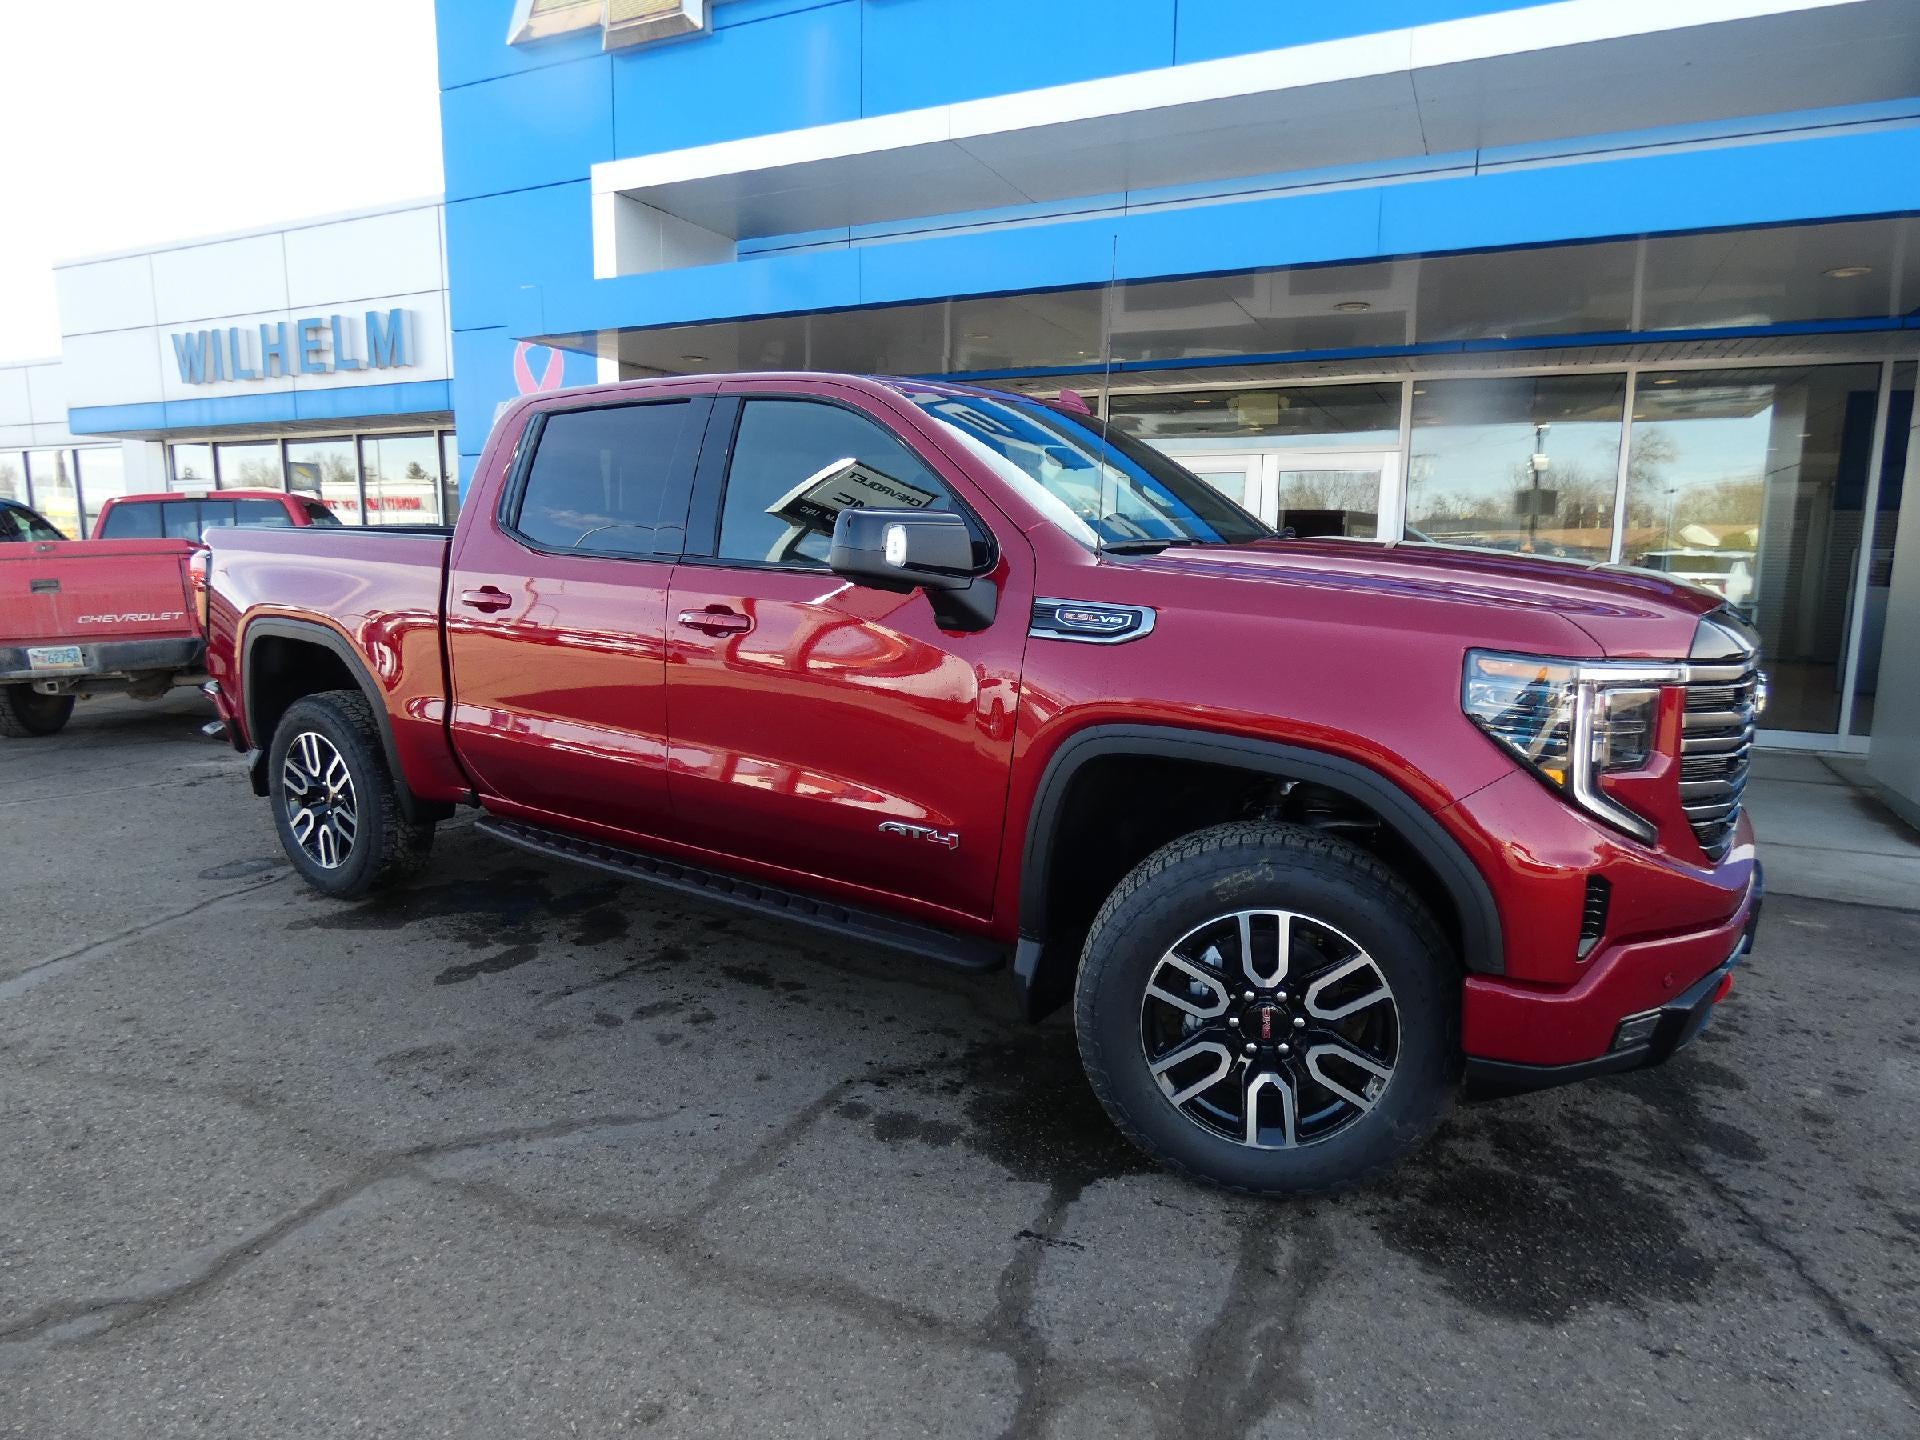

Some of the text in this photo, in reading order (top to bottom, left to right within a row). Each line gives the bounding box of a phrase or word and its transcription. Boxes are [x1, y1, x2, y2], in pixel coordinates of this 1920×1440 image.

[171, 309, 412, 384] WILHELM
[78, 611, 183, 624] CHEVROLET
[879, 821, 959, 850] AT4
